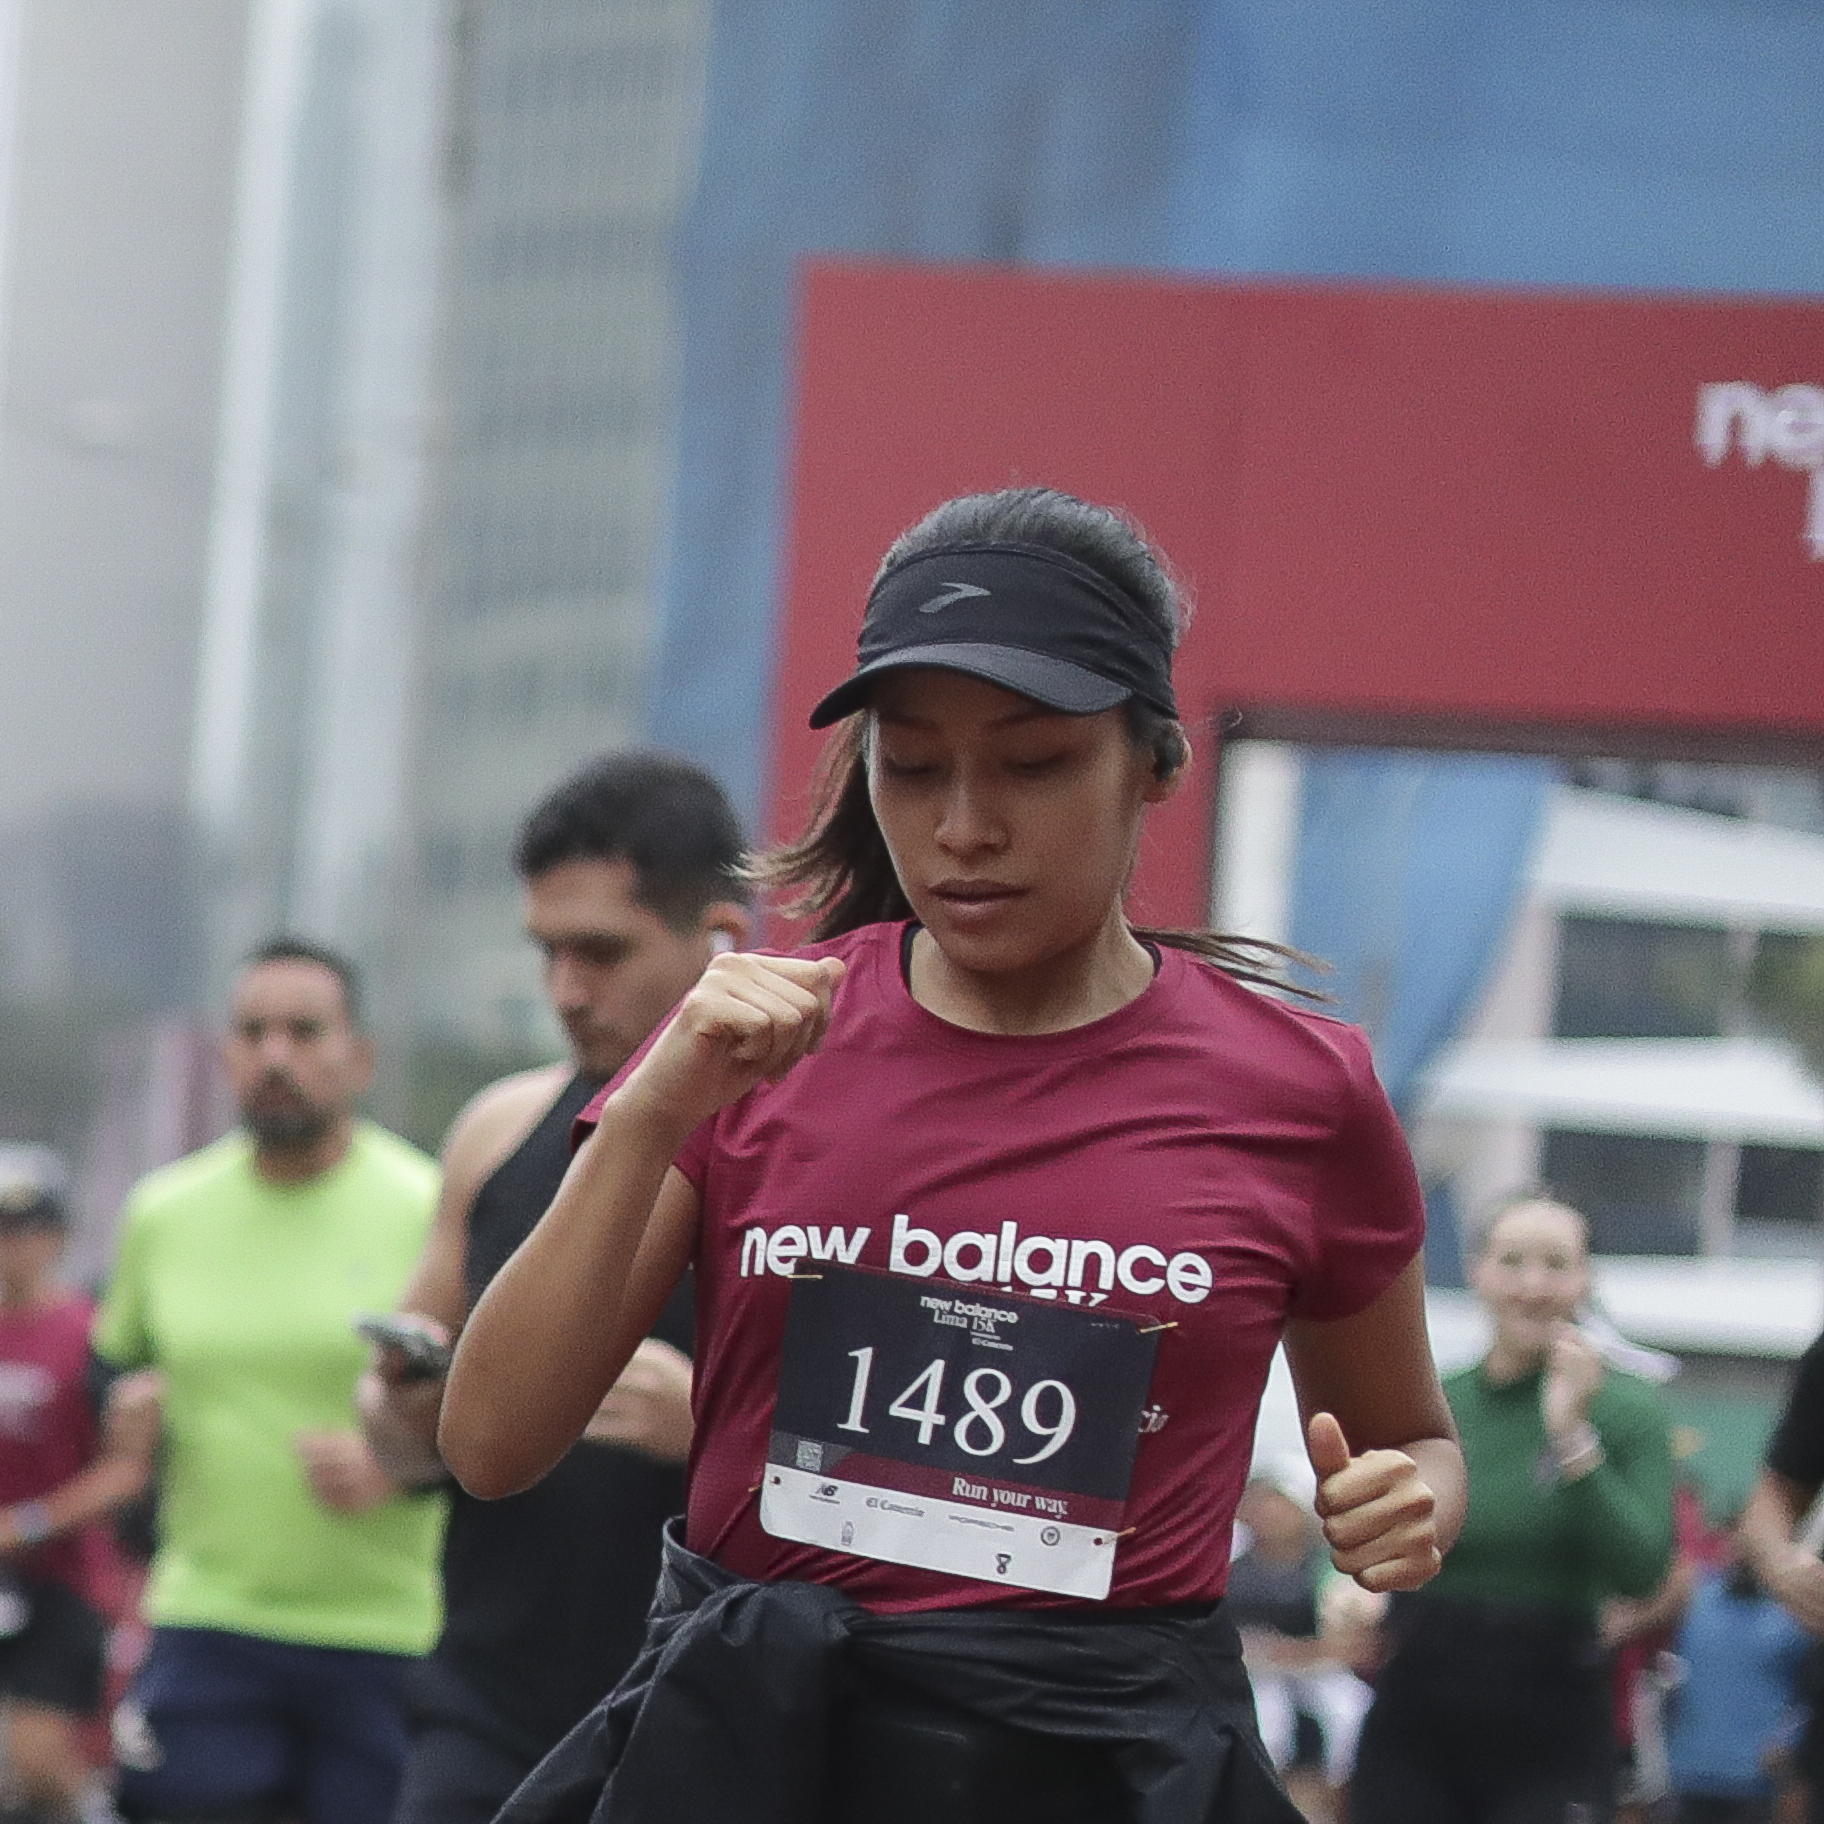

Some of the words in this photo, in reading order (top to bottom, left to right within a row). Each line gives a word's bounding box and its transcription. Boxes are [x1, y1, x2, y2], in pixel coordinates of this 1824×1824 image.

[1696, 380, 1824, 471] ne
[740, 1223, 872, 1278] new
[888, 1213, 1214, 1304] balance
[836, 1346, 1077, 1465] 1489
[952, 1476, 988, 1501] Run
[990, 1488, 1033, 1508] your
